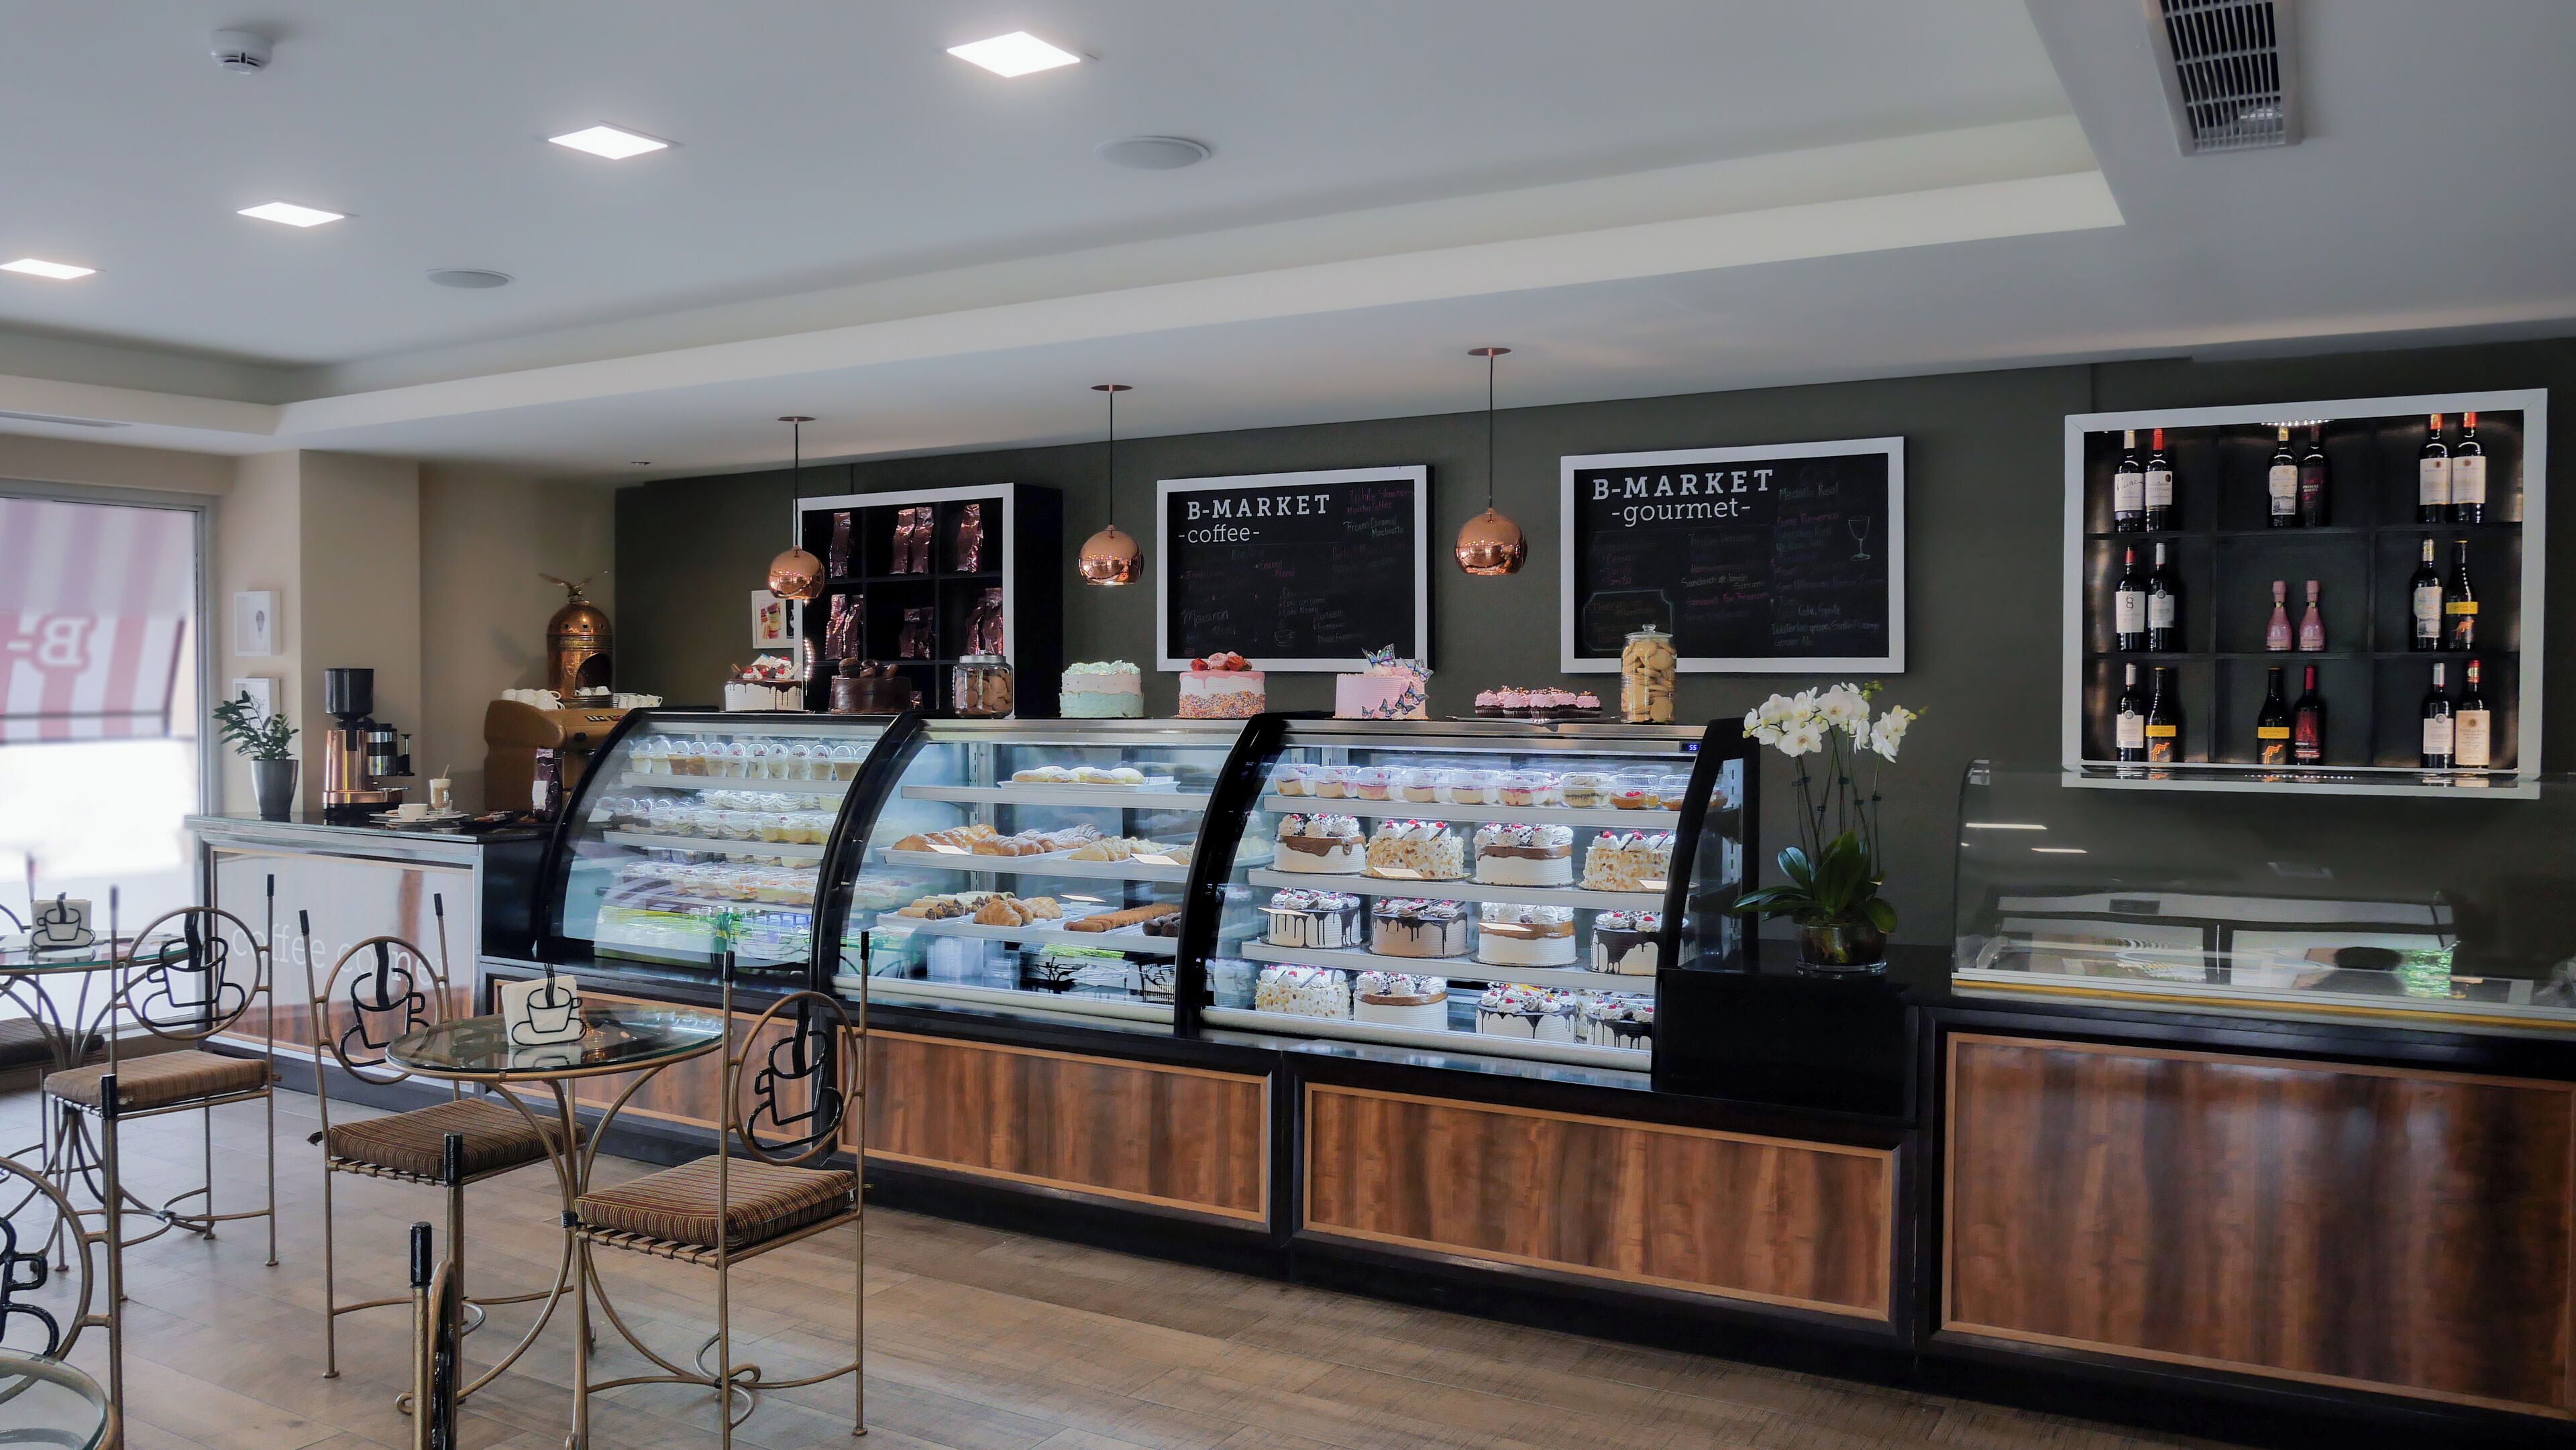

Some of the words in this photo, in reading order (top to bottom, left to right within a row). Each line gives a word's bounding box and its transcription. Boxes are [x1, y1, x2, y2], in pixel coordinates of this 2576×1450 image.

[1593, 469, 1774, 500] B-MARKET
[1187, 494, 1330, 520] B-MARKET
[1611, 498, 1751, 527] -gourmet-
[1179, 524, 1260, 544] -coffee-
[231, 923, 326, 968] coffee
